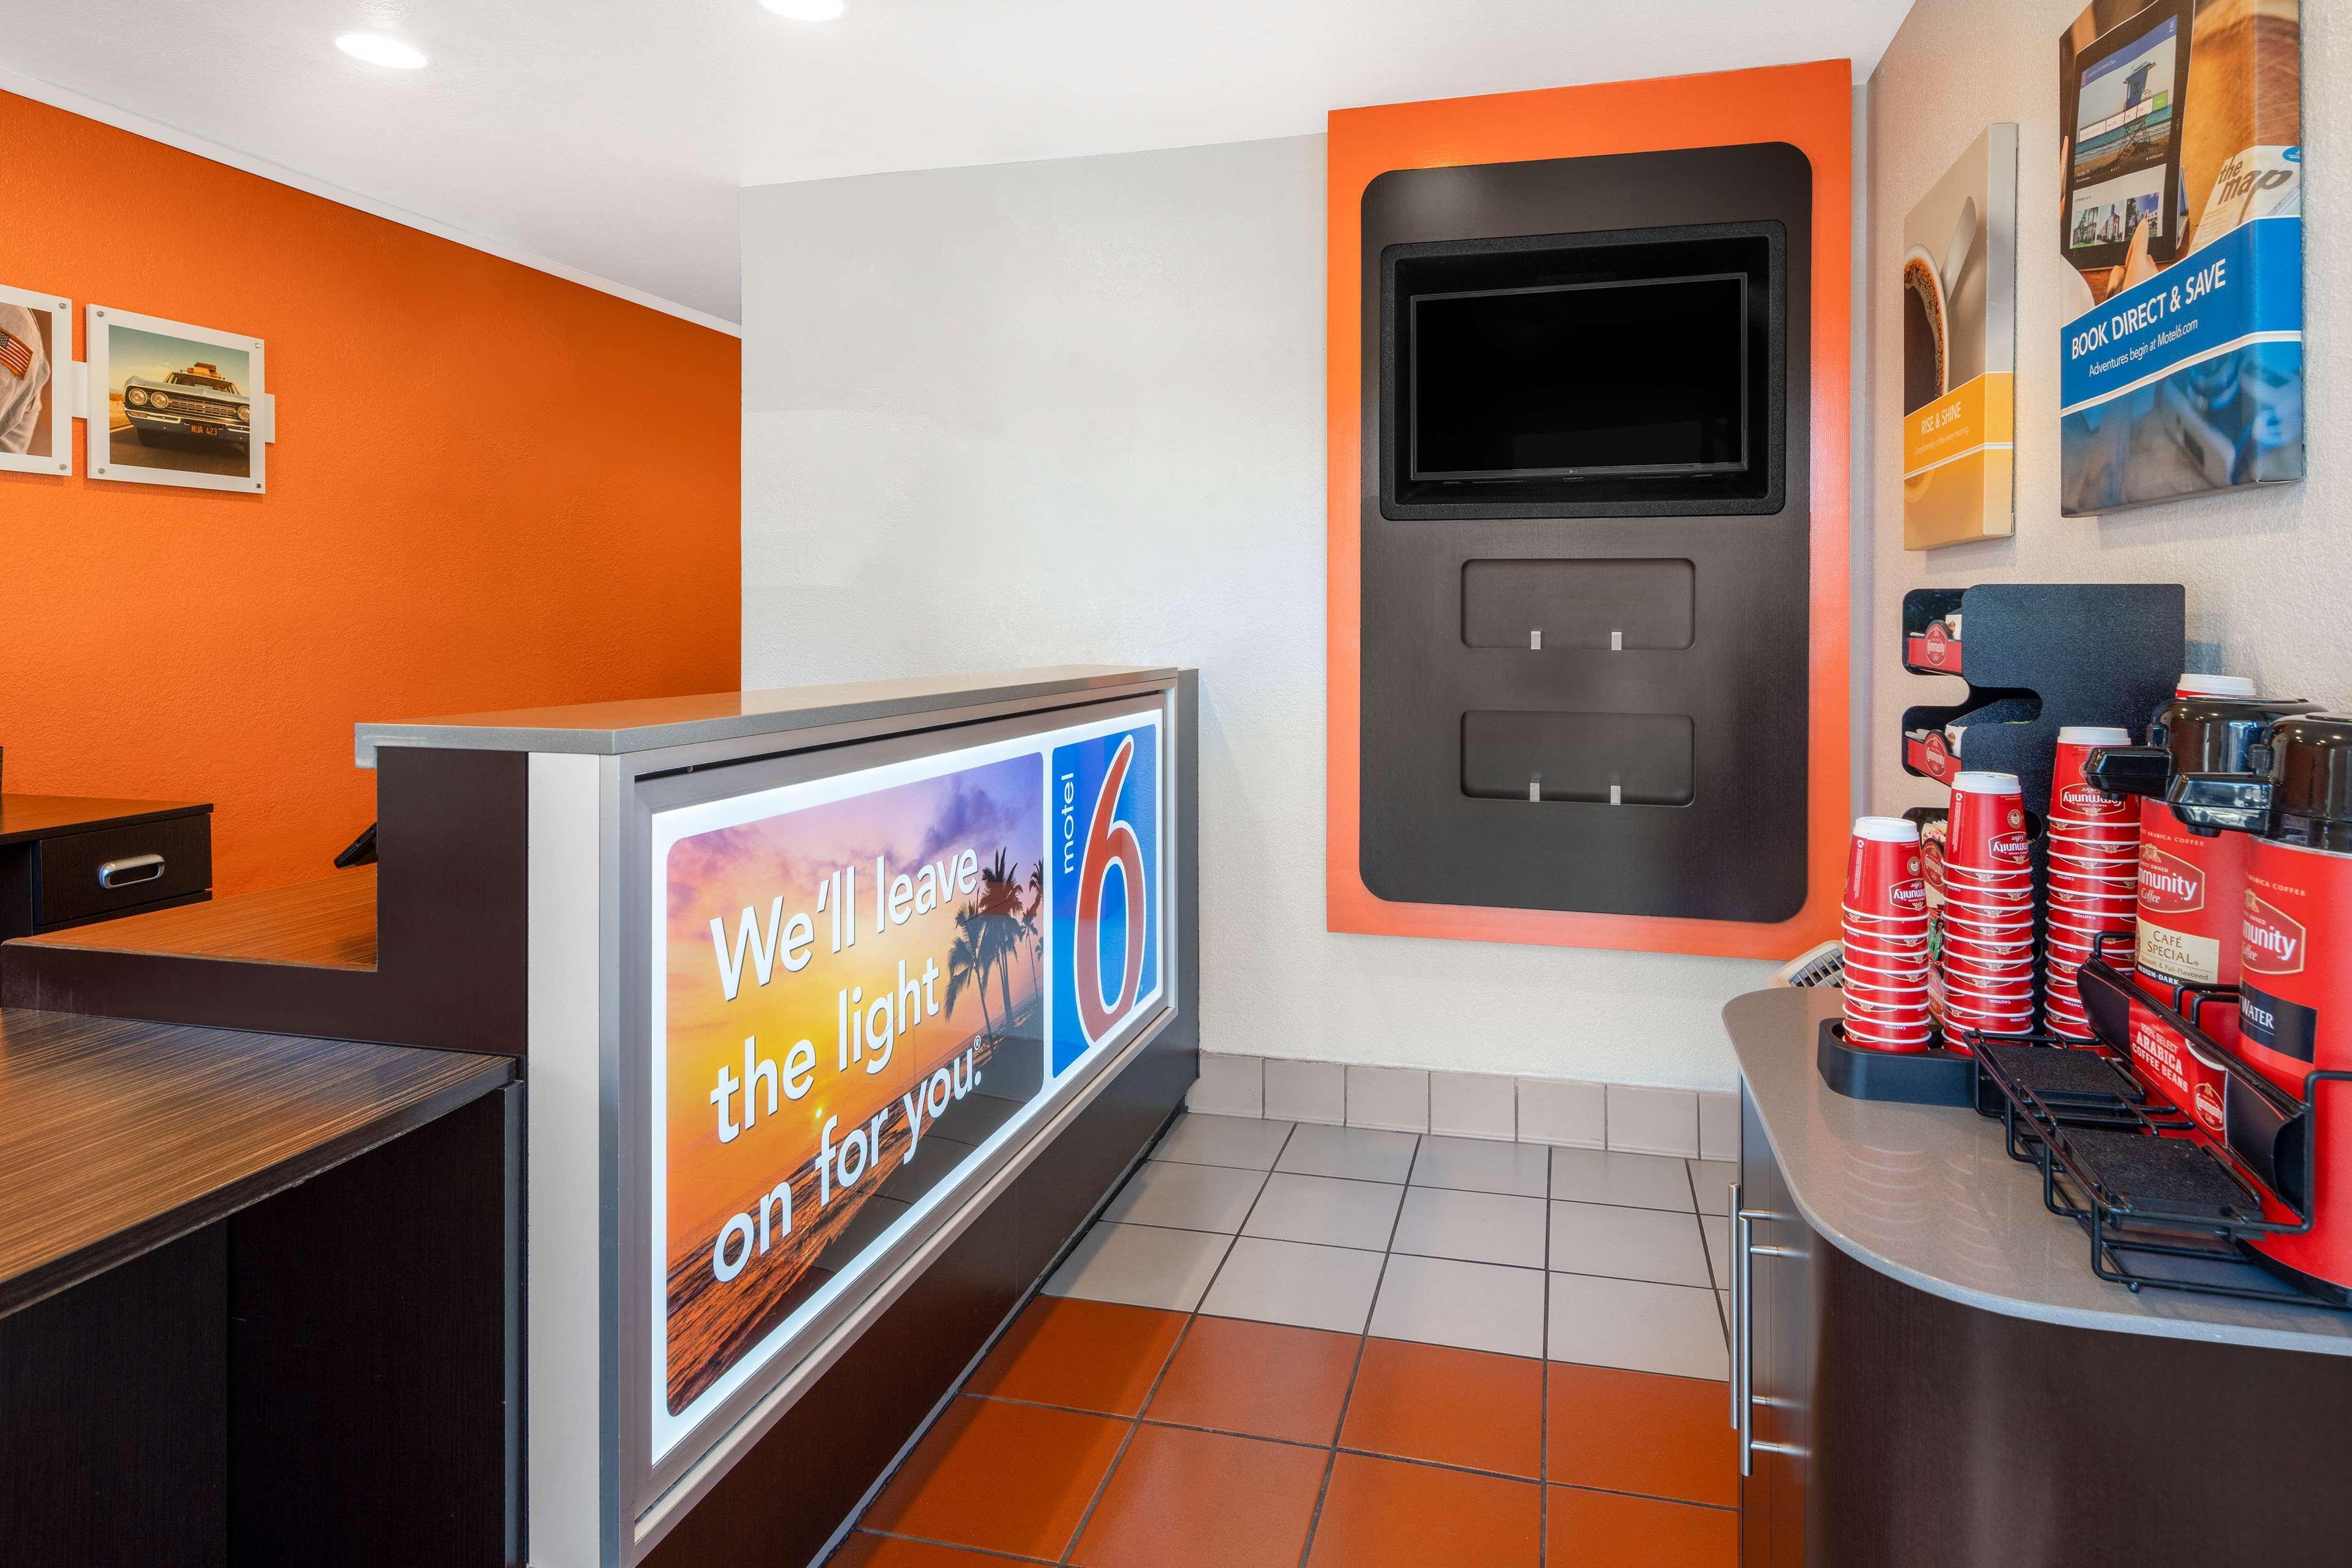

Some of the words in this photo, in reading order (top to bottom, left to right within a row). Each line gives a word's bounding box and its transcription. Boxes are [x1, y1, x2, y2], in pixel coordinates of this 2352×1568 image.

[2218, 157, 2243, 184] the
[2217, 170, 2293, 227] map
[2071, 321, 2109, 360] BOOK
[2112, 292, 2166, 341] DIRECT
[2170, 285, 2181, 312] &
[2185, 258, 2226, 304] SAVE
[2089, 353, 2128, 377] Adventures
[2130, 343, 2148, 361] begin
[2149, 339, 2157, 353] at
[2157, 318, 2198, 347] Motel6.com
[191, 424, 203, 434] NUA
[206, 426, 218, 436] 423
[1921, 415, 1934, 435] RISE
[1935, 412, 1940, 429] &
[1942, 401, 1961, 426] SHINE
[1061, 772, 1074, 875] motel
[2174, 837, 2206, 847] COFFEE
[1074, 734, 1147, 1048] 6
[2141, 888, 2161, 904] Coffee
[2272, 883, 2306, 897] COFFEE
[709, 865, 856, 1001] We'll
[877, 848, 978, 933] leave
[2153, 930, 2182, 948] CAFÉ
[2165, 964, 2209, 981] Full-Flavored
[2242, 995, 2275, 1030] WATER
[710, 1035, 816, 1144] the
[839, 957, 940, 1074] light
[2136, 1031, 2184, 1076] ARABICA
[2141, 1022, 2156, 1041] 100%
[2156, 1033, 2179, 1055] SELECT
[2132, 1042, 2160, 1072] COFFEE
[2161, 1065, 2188, 1093] BEANS
[713, 1182, 792, 1283] on
[815, 1114, 888, 1208] for
